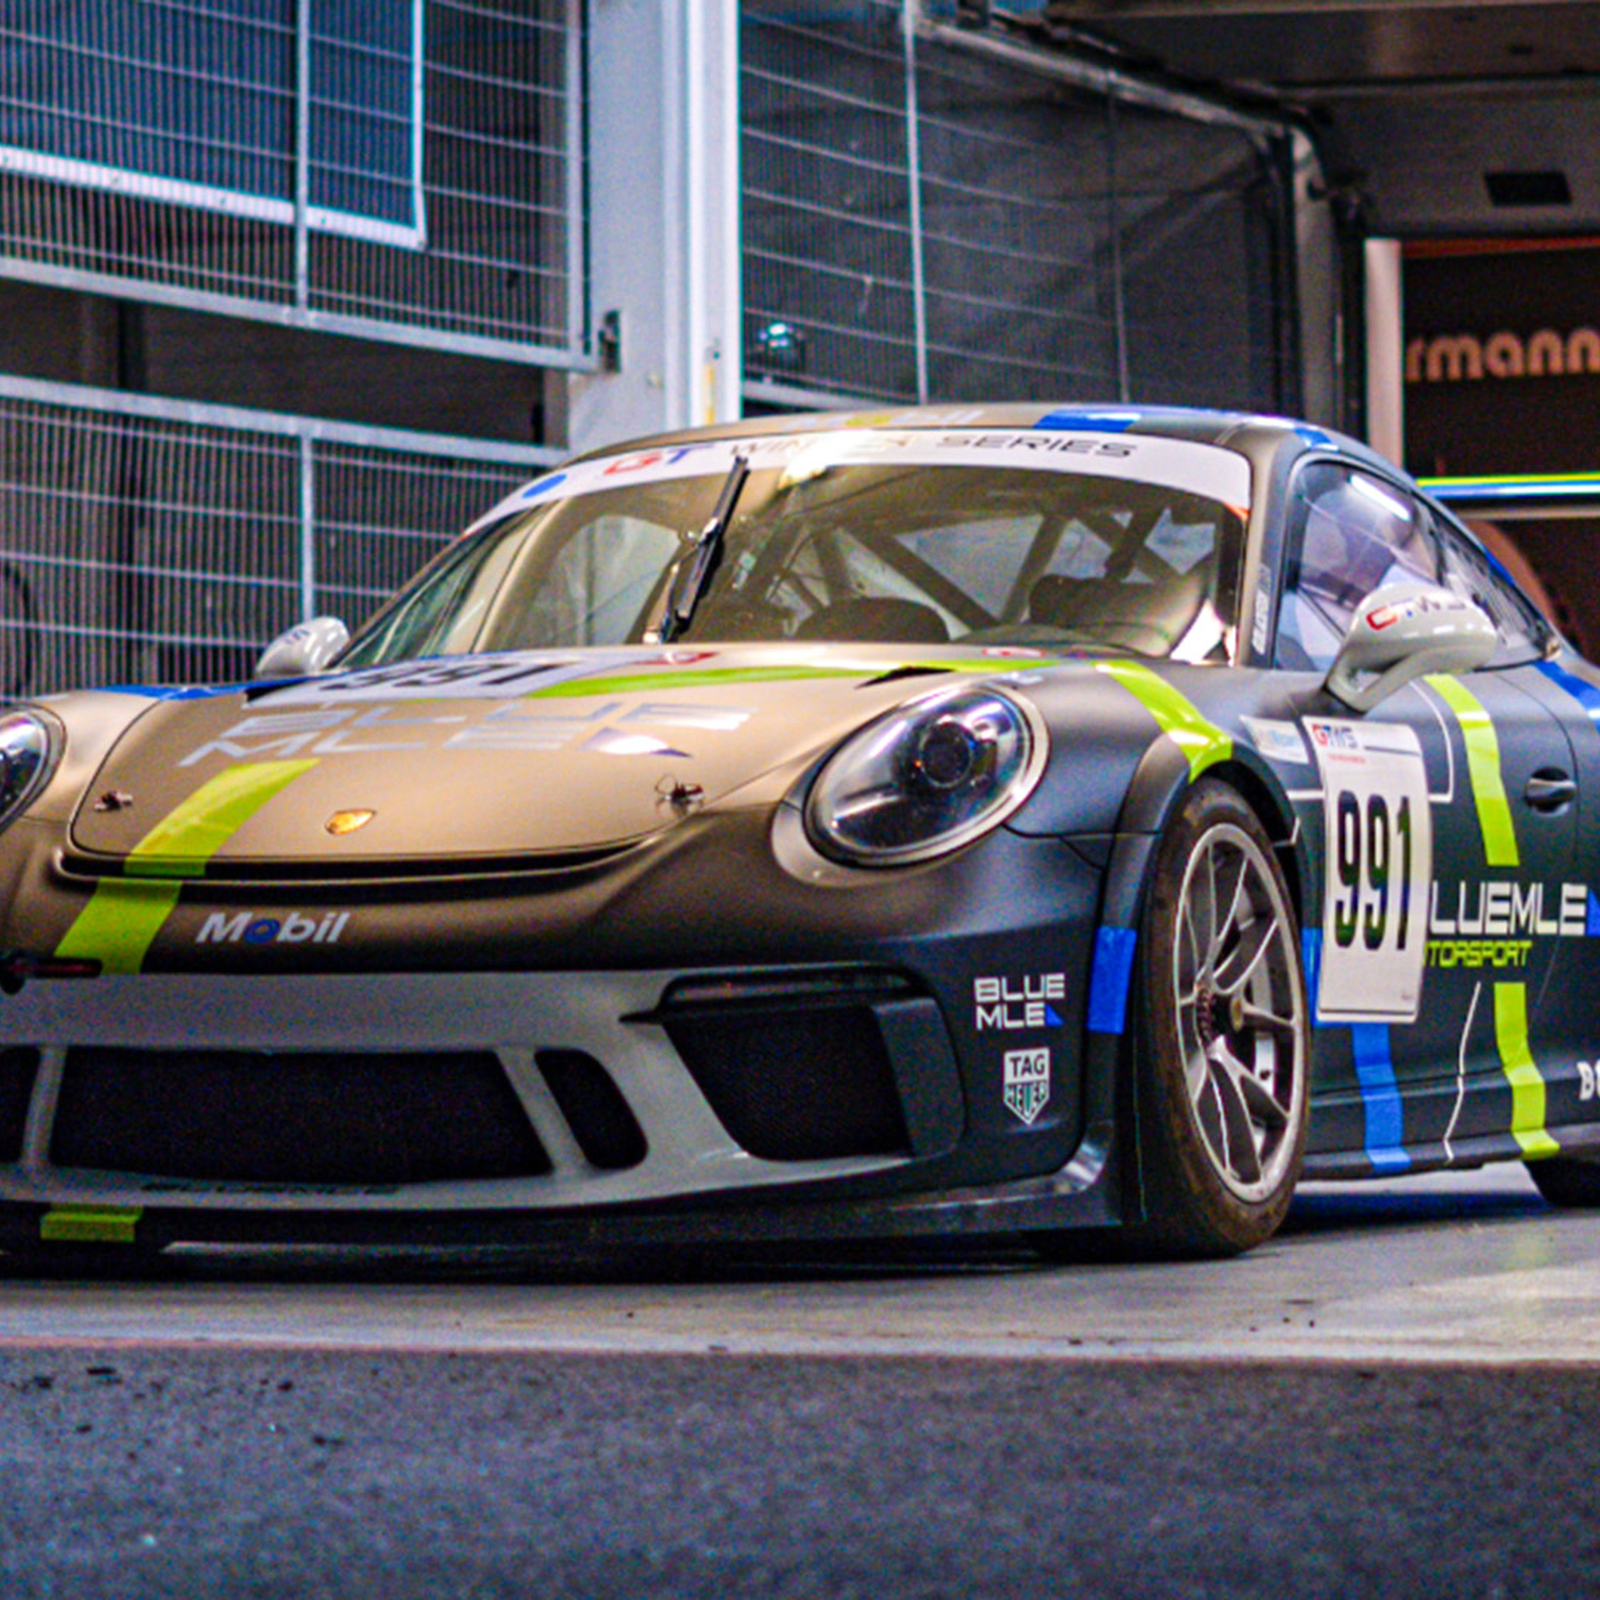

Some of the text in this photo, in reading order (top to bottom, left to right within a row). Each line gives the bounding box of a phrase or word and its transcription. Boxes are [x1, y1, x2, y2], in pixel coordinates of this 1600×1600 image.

[936, 434, 1138, 459] SERIES
[1335, 790, 1411, 951] 991
[196, 912, 350, 944] Mobil
[974, 973, 1065, 1003] BLUE
[976, 1002, 1045, 1031] MLE
[1009, 1053, 1045, 1078] TAG
